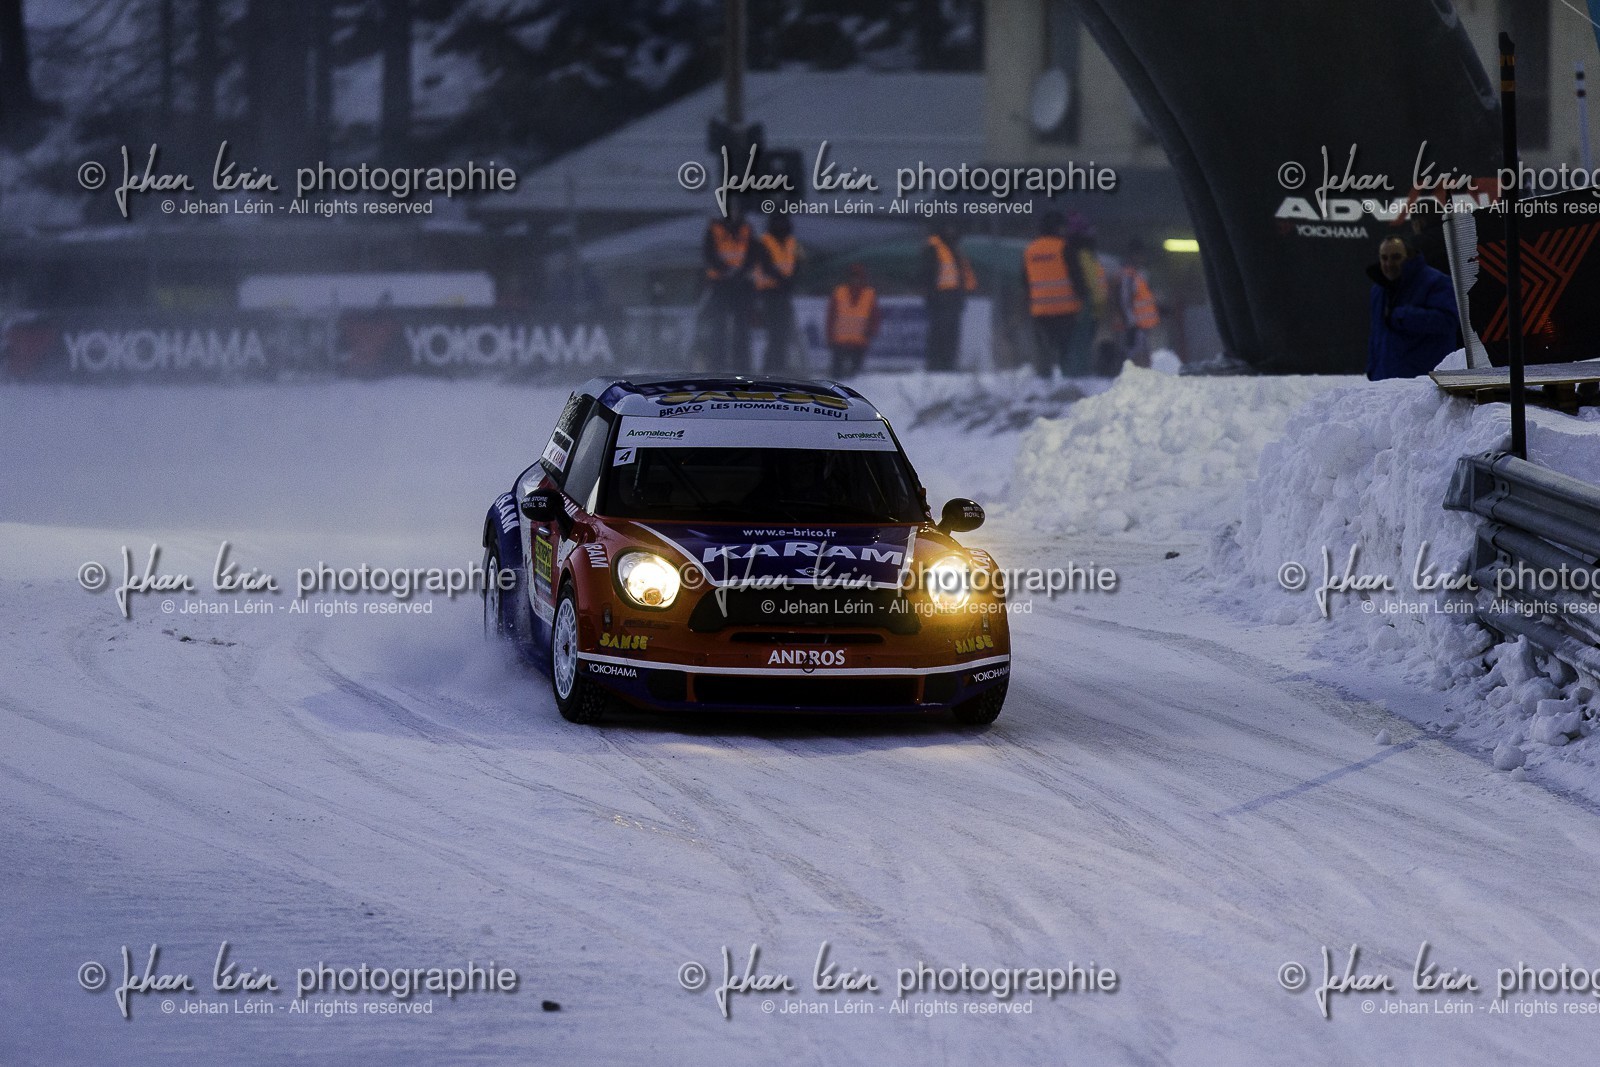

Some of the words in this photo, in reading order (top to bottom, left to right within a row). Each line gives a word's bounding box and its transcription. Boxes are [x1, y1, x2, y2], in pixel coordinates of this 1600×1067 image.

[1296, 225, 1368, 239] YOKOHAMA
[64, 328, 267, 371] YOKOHAMA
[403, 324, 614, 365] YOKOHAMA
[734, 402, 790, 411] HOMMES
[794, 405, 810, 413] EN
[813, 407, 842, 419] BLEU
[618, 450, 632, 462] 4
[743, 528, 837, 539] www.e-brico.fr
[702, 542, 904, 566] KARAM
[600, 633, 649, 650] SAMSE
[955, 634, 994, 655] SAMSE
[768, 649, 846, 666] ANDROS
[588, 663, 638, 679] YOKOHAMA
